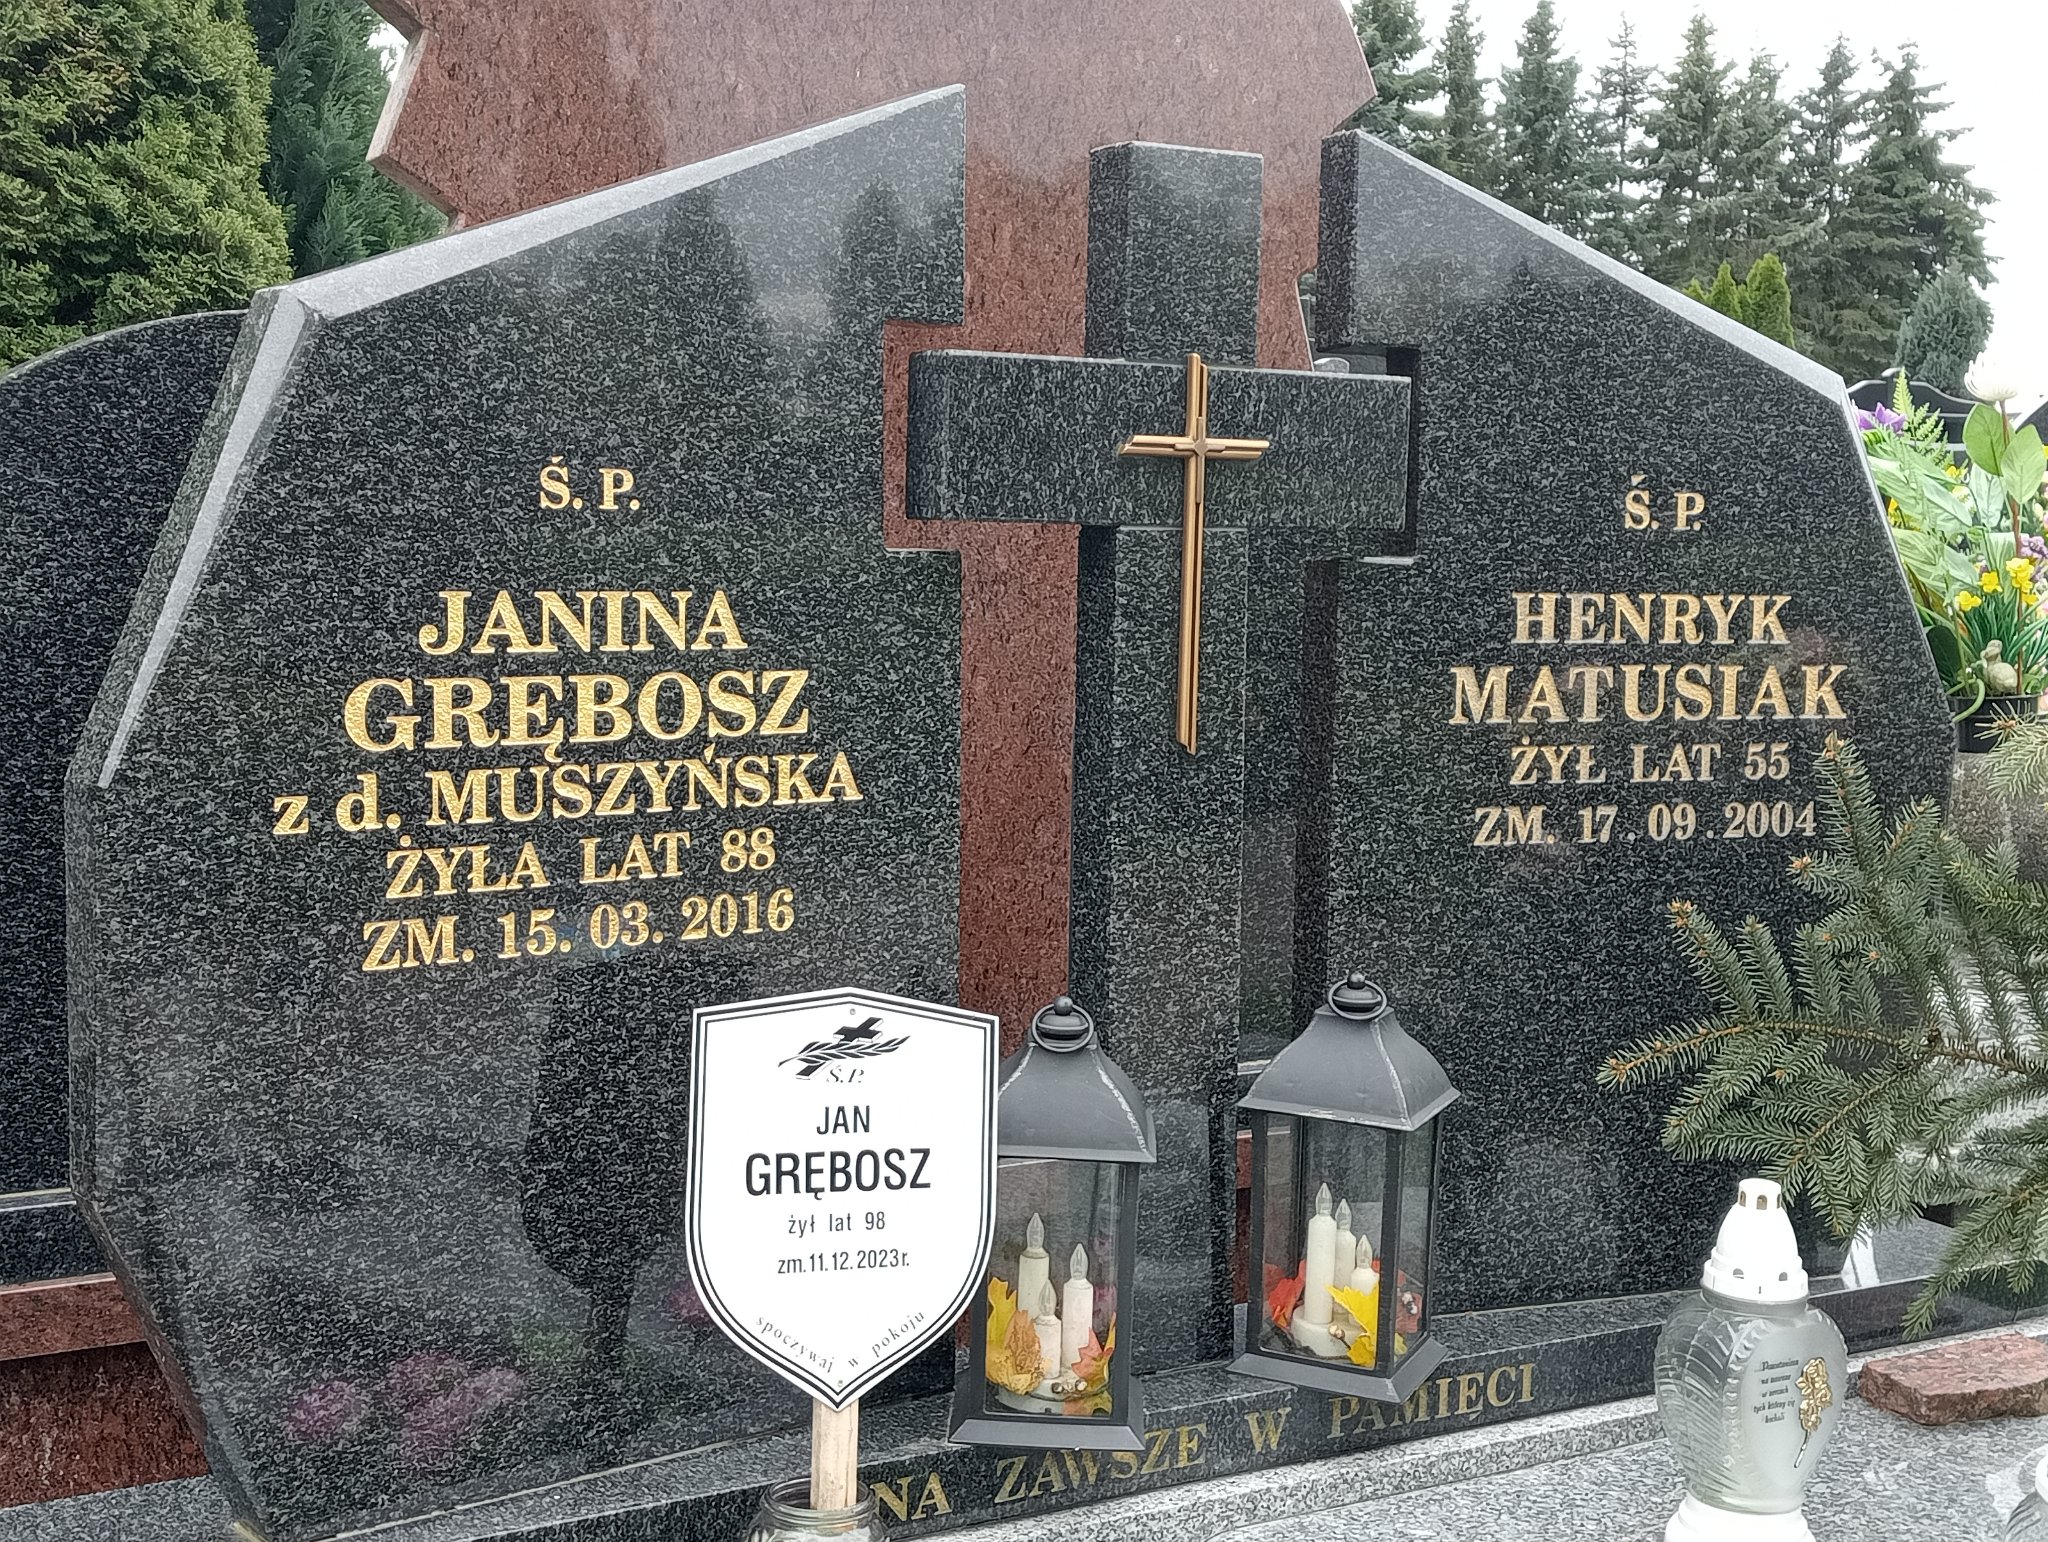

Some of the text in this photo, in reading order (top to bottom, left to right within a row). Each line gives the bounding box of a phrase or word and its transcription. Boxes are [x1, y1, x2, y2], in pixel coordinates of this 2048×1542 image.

[539, 457, 641, 510] Ś. P.
[1624, 474, 1706, 530] Ś. P.
[418, 589, 748, 655] JANINA
[1511, 592, 1792, 645] HENRYK
[344, 669, 809, 762] GRĘBOSZ
[1449, 664, 1848, 726] MATUSIAK
[272, 743, 864, 835] z d. MUSZYŃSKA
[1509, 736, 1790, 785] ŻYŁ LAT 55
[1474, 805, 1555, 847] ZM.
[1723, 801, 1817, 840] 2004
[386, 827, 776, 900] ŻYŁA LAT 88
[362, 888, 795, 972] ZM. 15. 03. 2016
[817, 1105, 870, 1135] JAN
[746, 1148, 931, 1200] GRĘBOSZ
[788, 1211, 885, 1238] żył lat 98
[756, 1312, 925, 1374] spoczywaj w pokoju
[869, 1472, 952, 1522] NA
[1244, 1406, 1292, 1451] W
